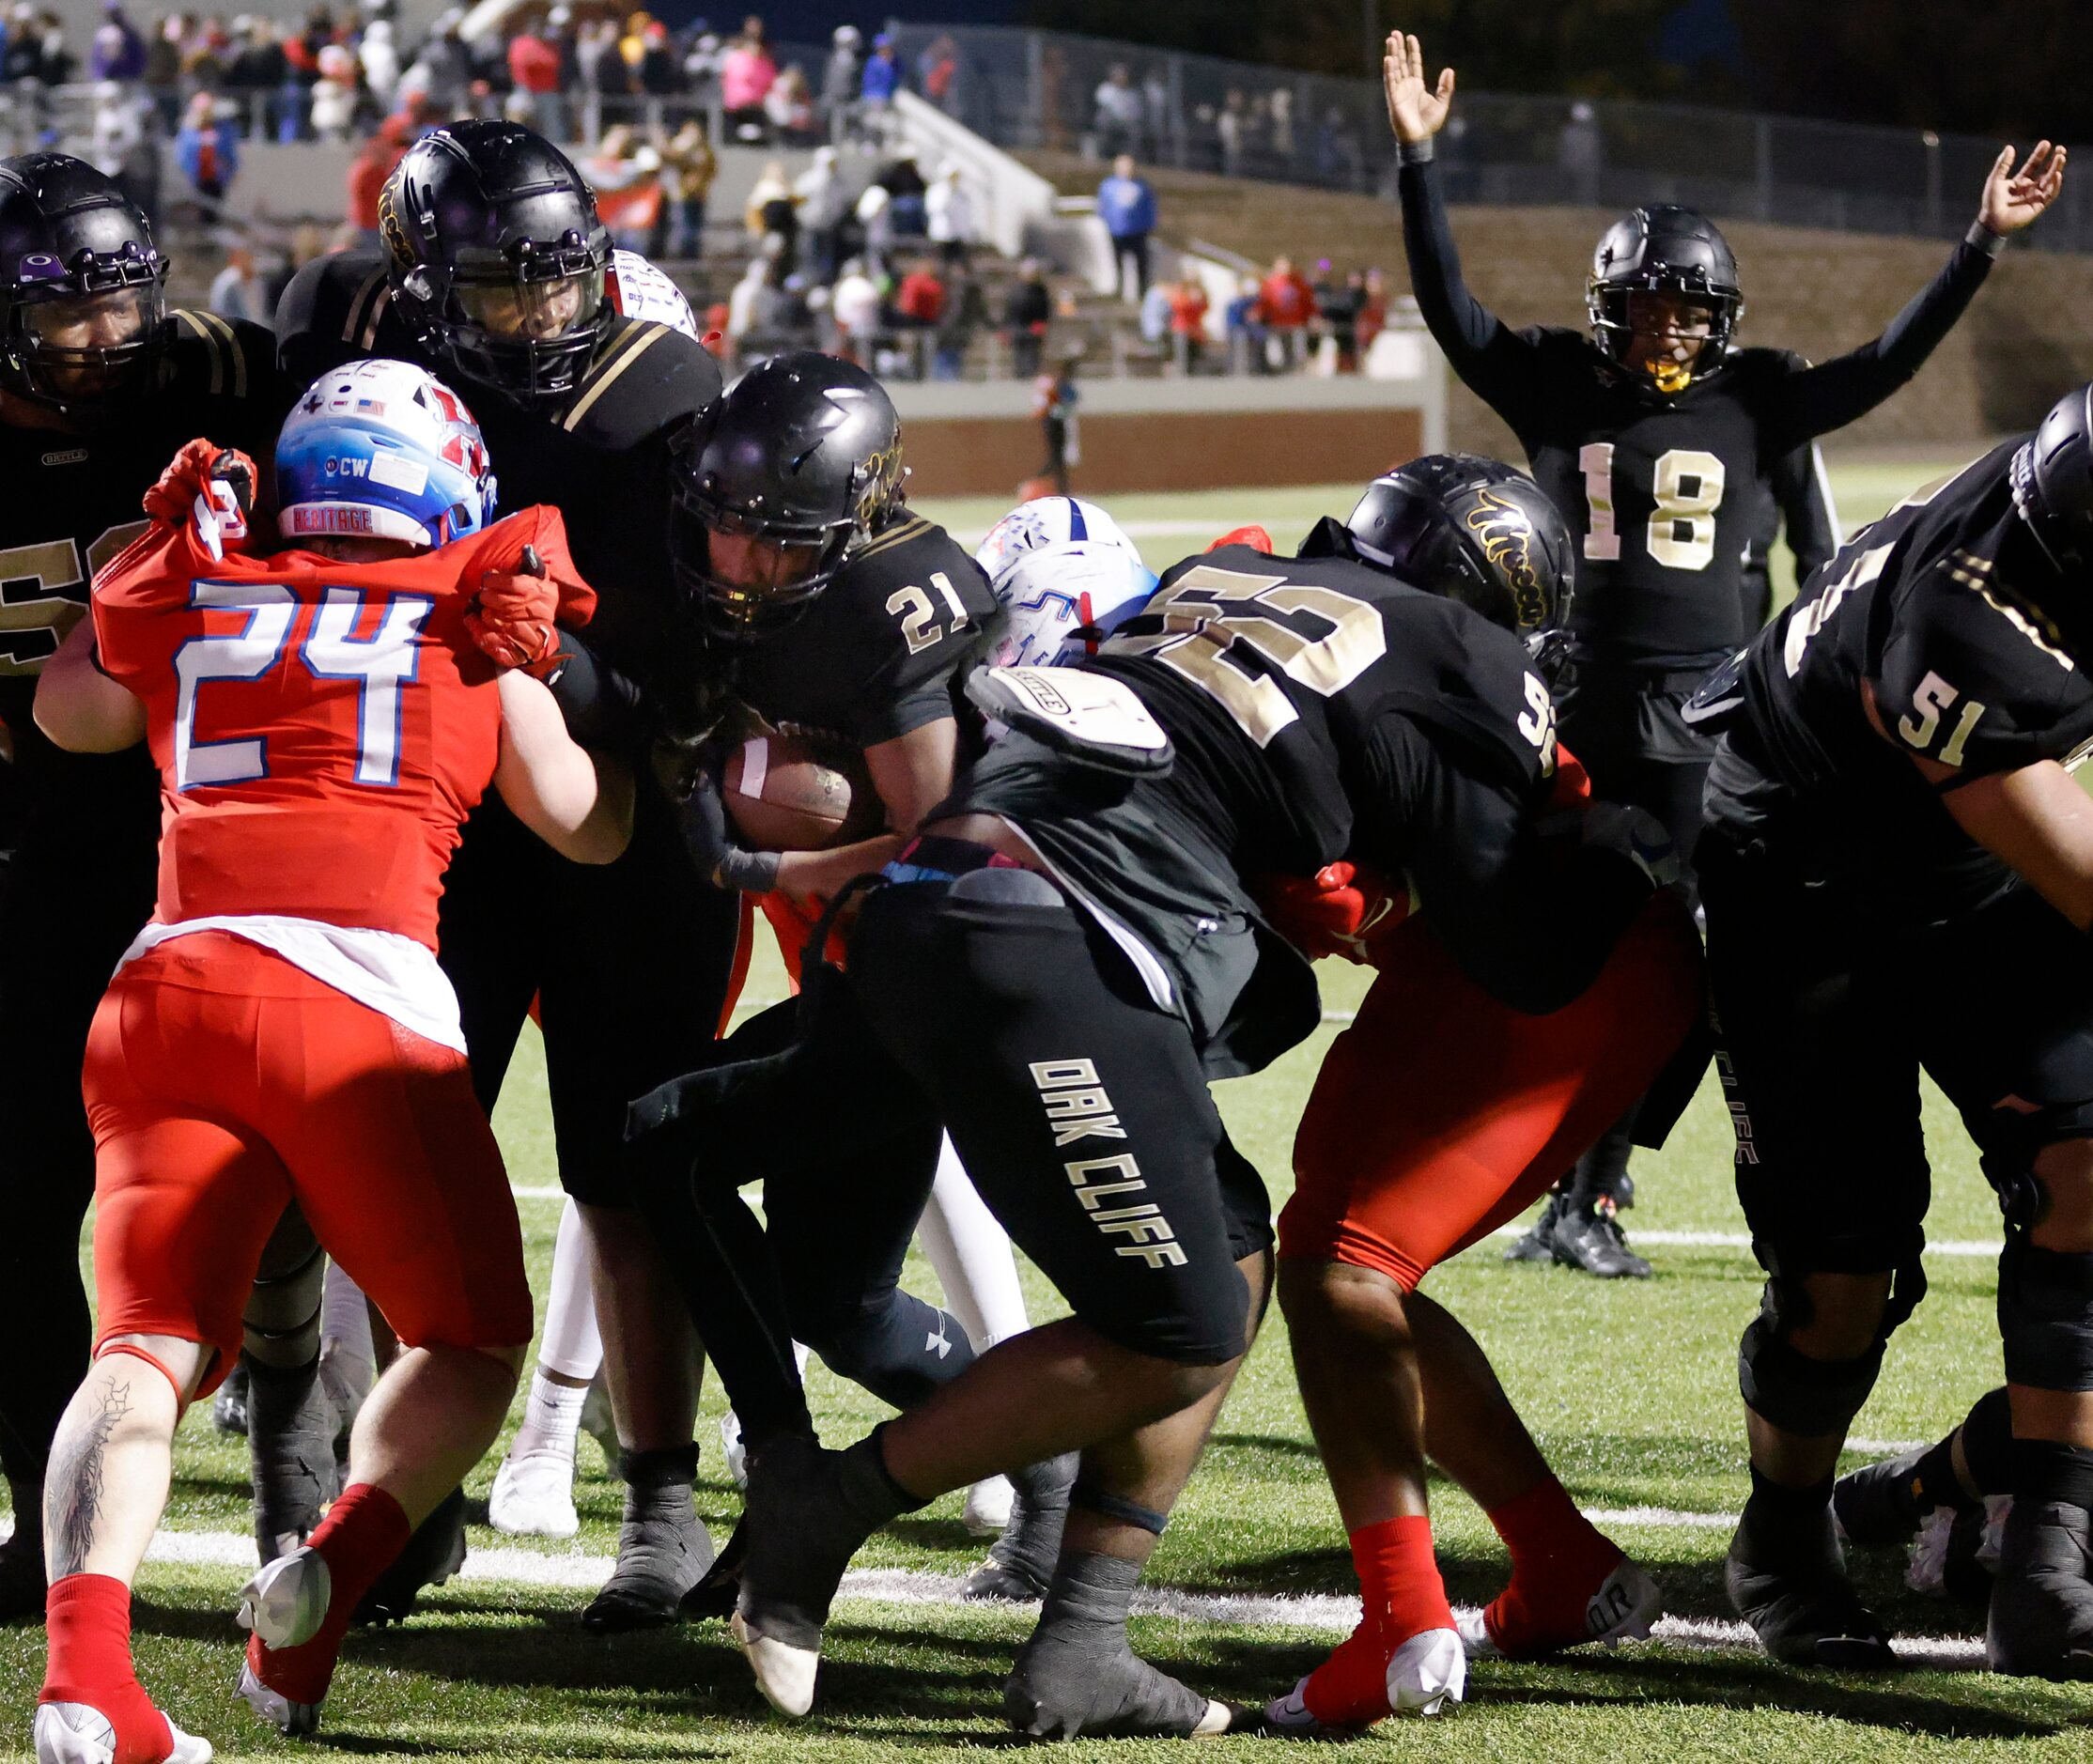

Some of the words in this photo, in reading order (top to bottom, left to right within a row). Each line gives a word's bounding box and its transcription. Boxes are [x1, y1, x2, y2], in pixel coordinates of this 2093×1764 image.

[340, 456, 368, 478] CW
[1579, 442, 1726, 572] 18
[293, 507, 373, 534] HERITAGE
[885, 571, 969, 656] 21
[172, 578, 435, 793] 24
[1898, 670, 1986, 767] 51
[1028, 1058, 1127, 1148] OAK
[1063, 1153, 1188, 1268] CLIFF
